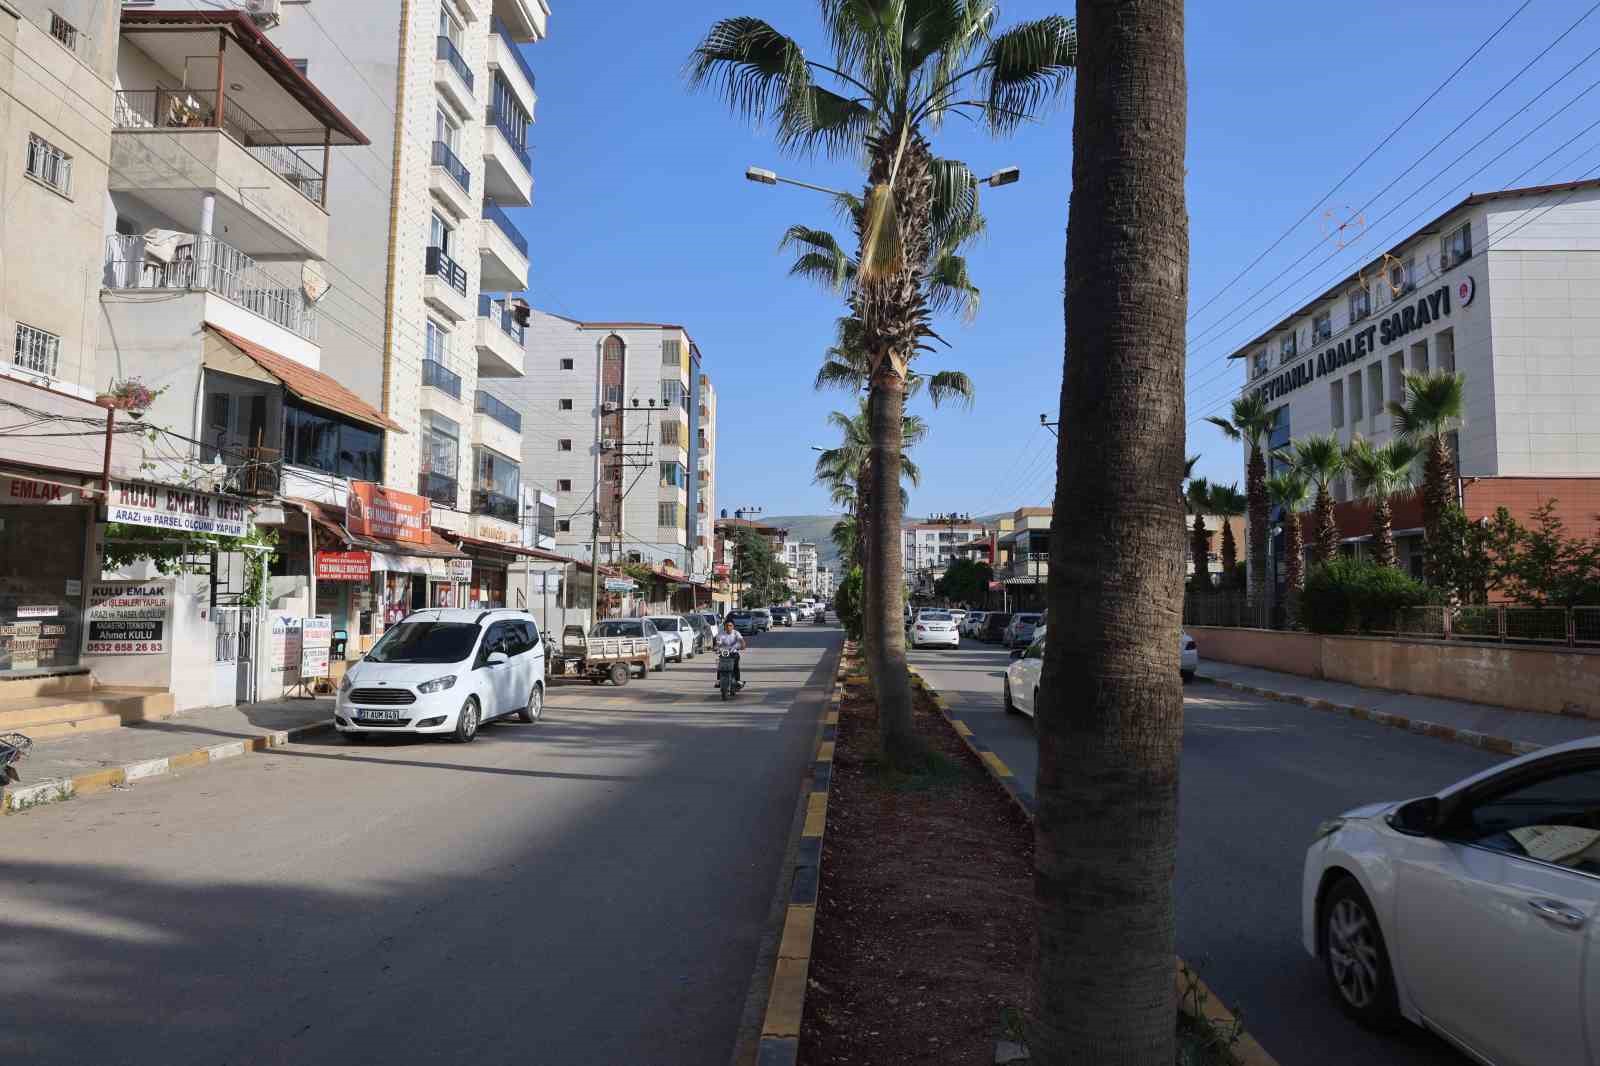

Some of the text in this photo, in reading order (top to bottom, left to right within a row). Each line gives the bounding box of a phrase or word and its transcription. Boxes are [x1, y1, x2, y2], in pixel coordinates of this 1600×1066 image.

[1316, 325, 1376, 378] ADALET
[1380, 286, 1450, 345] SARAYI
[11, 480, 61, 500] EMLAK
[167, 487, 210, 516] EMLAK
[143, 515, 152, 523] ve
[154, 514, 182, 528] PARSEL
[216, 523, 242, 535] YAPILIR
[92, 587, 165, 596] KULU EMLAK
[142, 598, 167, 607] YAPILIR
[100, 631, 152, 640] Ahmet KULU
[88, 643, 112, 652] 0532
[135, 643, 148, 652] 26
